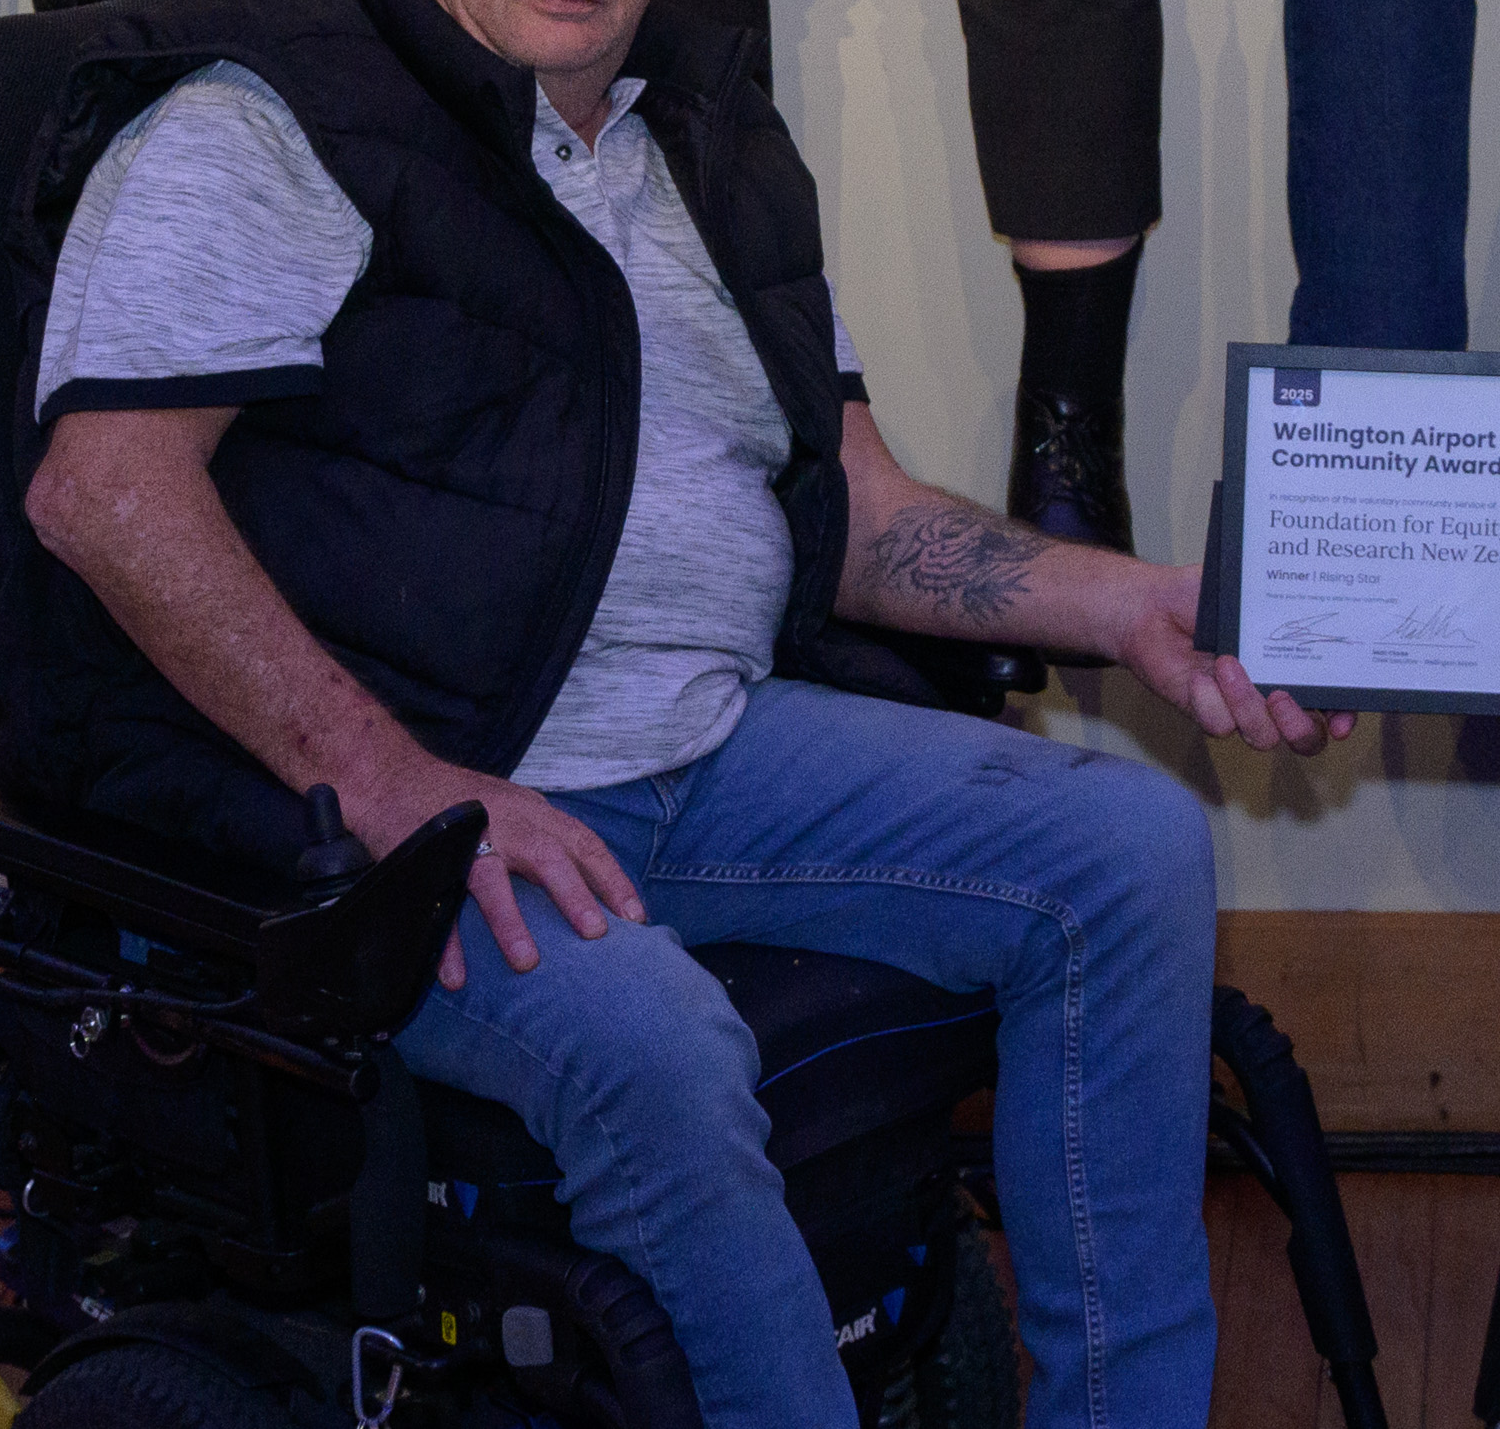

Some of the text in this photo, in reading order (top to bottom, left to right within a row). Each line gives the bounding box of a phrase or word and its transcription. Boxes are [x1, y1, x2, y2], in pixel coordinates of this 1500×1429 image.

[1280, 388, 1313, 401] 2025
[1273, 422, 1405, 449] Wellington
[1411, 426, 1496, 453] Airport
[1271, 448, 1417, 478] Community
[1280, 493, 1330, 506] recognition
[1332, 495, 1341, 503] of
[1359, 497, 1400, 507] voluntary
[1402, 499, 1452, 509] community
[1455, 501, 1485, 509] service
[1487, 501, 1497, 509] of
[1269, 509, 1396, 533] Foundation
[1403, 514, 1434, 535] for
[1268, 538, 1309, 556] and
[1316, 538, 1415, 561] Research
[1421, 543, 1468, 562] New
[1266, 570, 1380, 586] Winner Rising Star
